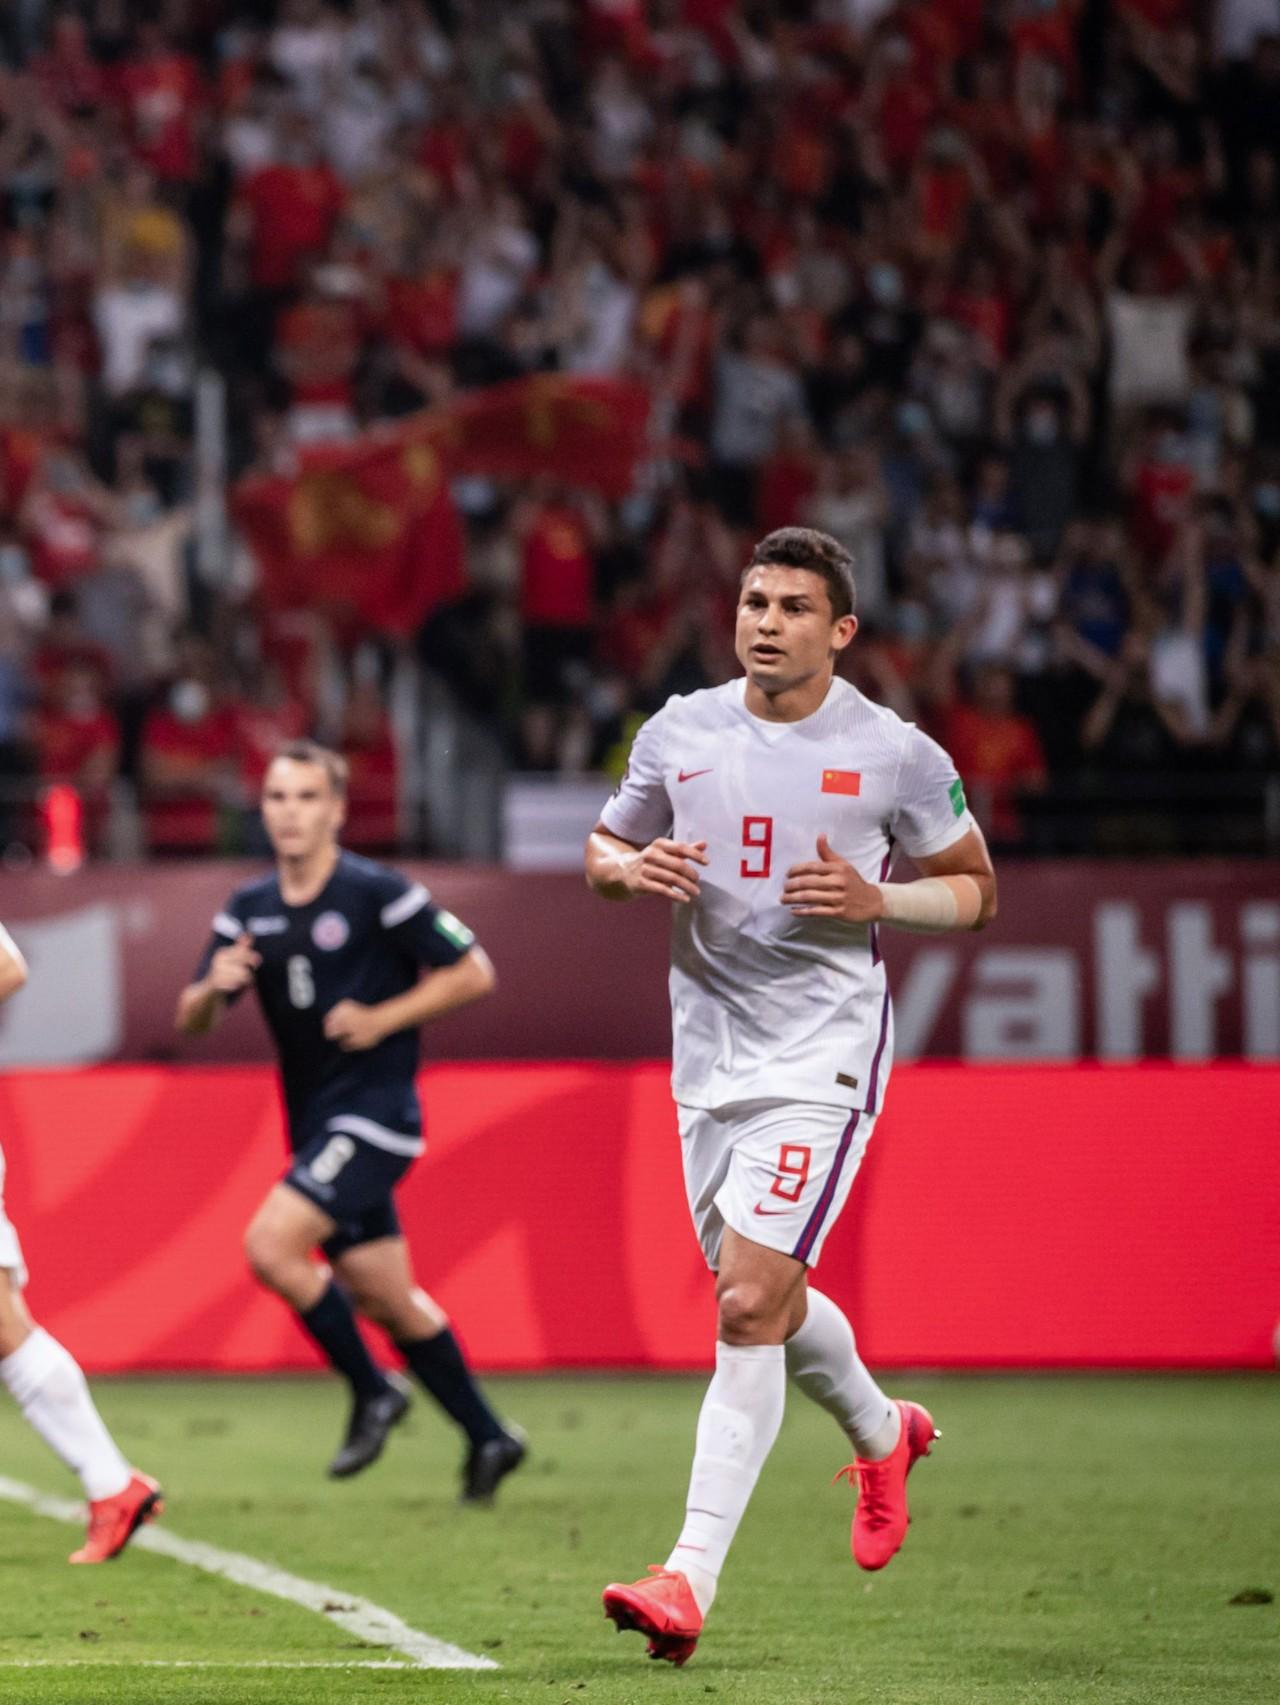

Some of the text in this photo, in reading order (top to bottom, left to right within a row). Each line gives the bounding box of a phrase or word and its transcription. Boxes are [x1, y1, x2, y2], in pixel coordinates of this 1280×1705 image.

[741, 816, 772, 877] 9
[287, 954, 316, 1009] 6
[770, 1144, 810, 1201] 9
